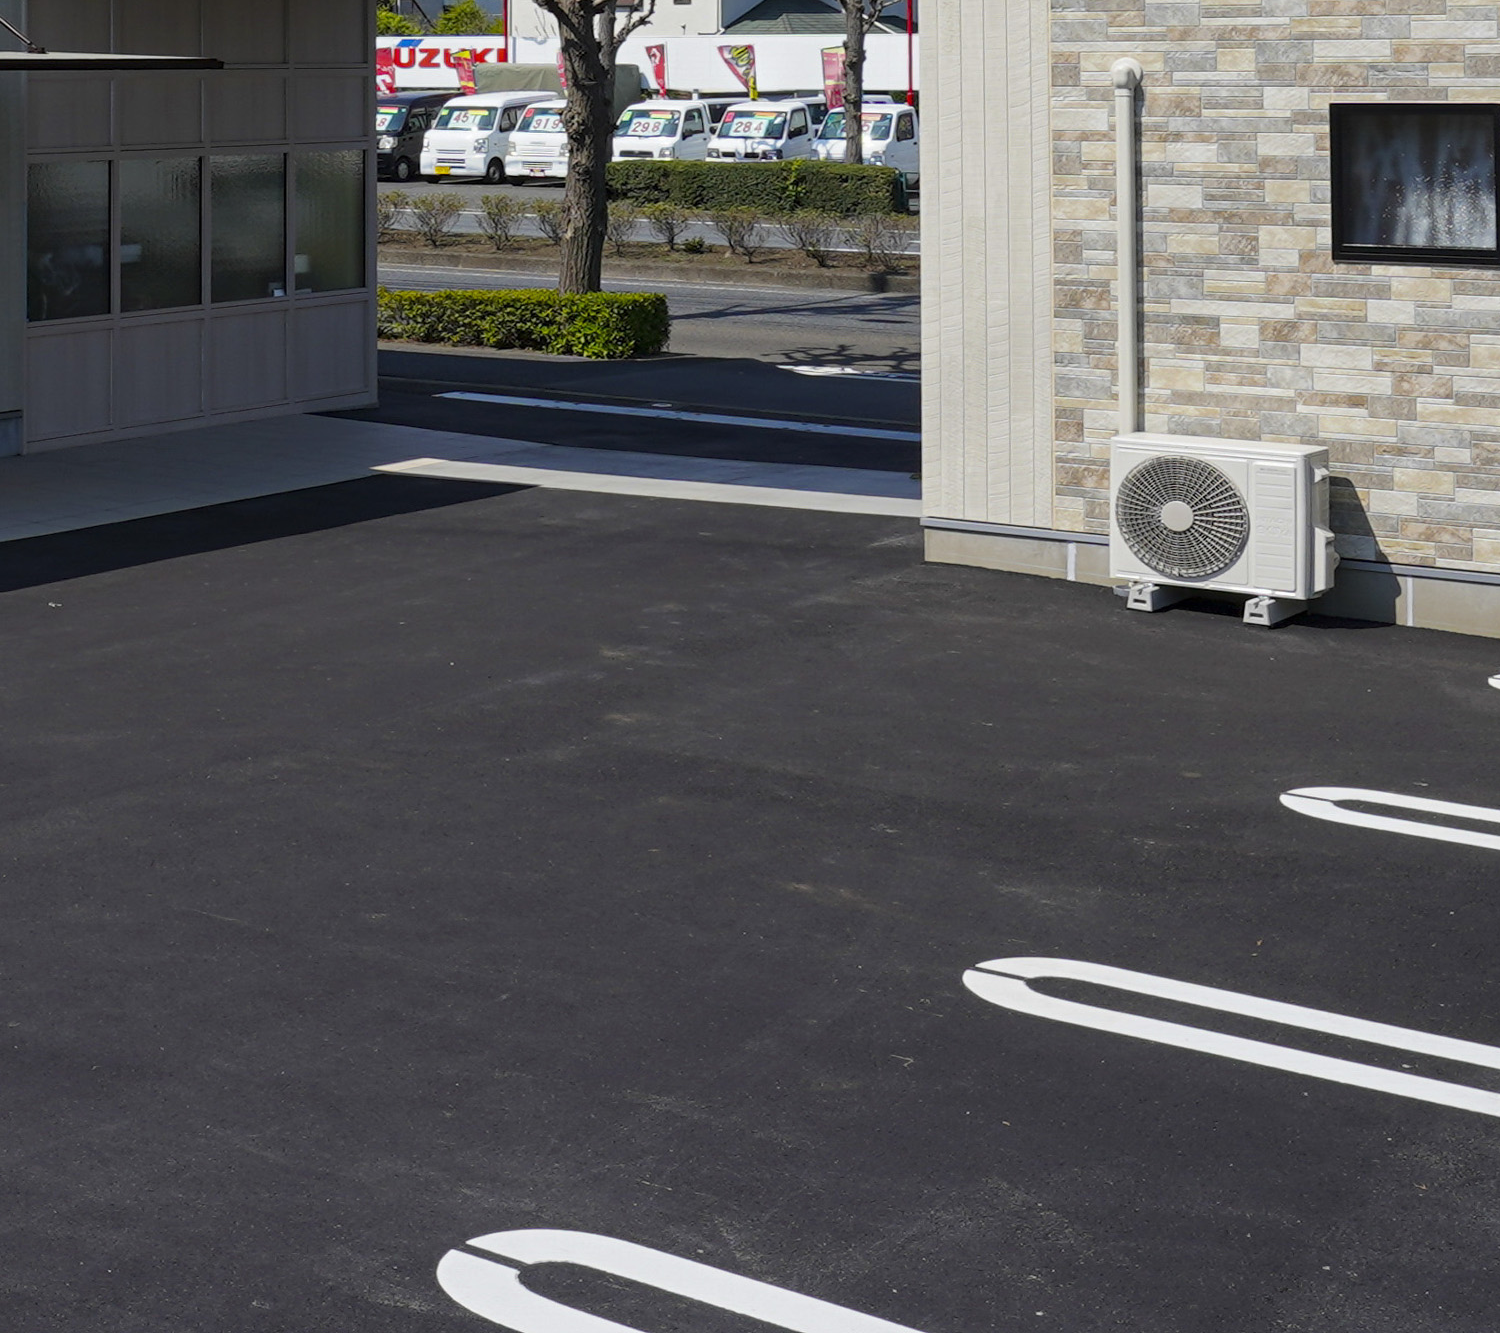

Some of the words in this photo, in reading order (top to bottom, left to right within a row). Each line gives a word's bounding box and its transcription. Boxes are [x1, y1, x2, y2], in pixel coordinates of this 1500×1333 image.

[393, 48, 508, 68] UZUKI
[631, 121, 661, 133] 298
[733, 121, 763, 133] 284
